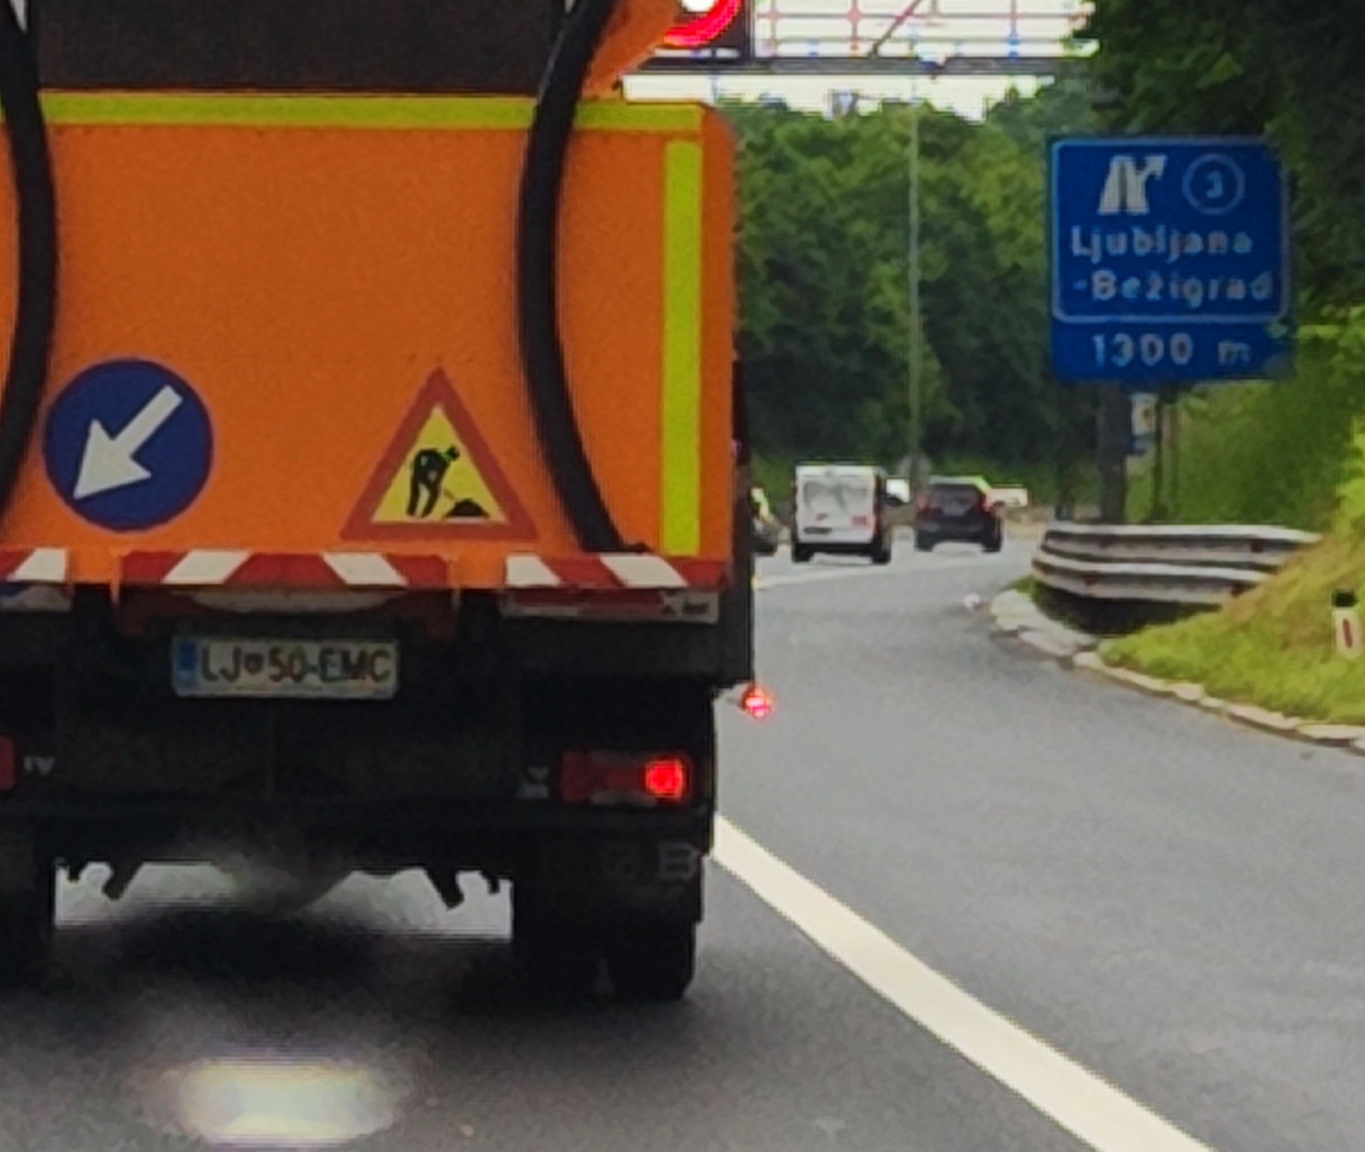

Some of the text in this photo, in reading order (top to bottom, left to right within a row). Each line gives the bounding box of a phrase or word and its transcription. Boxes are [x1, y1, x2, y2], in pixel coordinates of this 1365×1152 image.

[1071, 225, 1253, 265] Ljubljana
[1092, 332, 1251, 367] 1300 m
